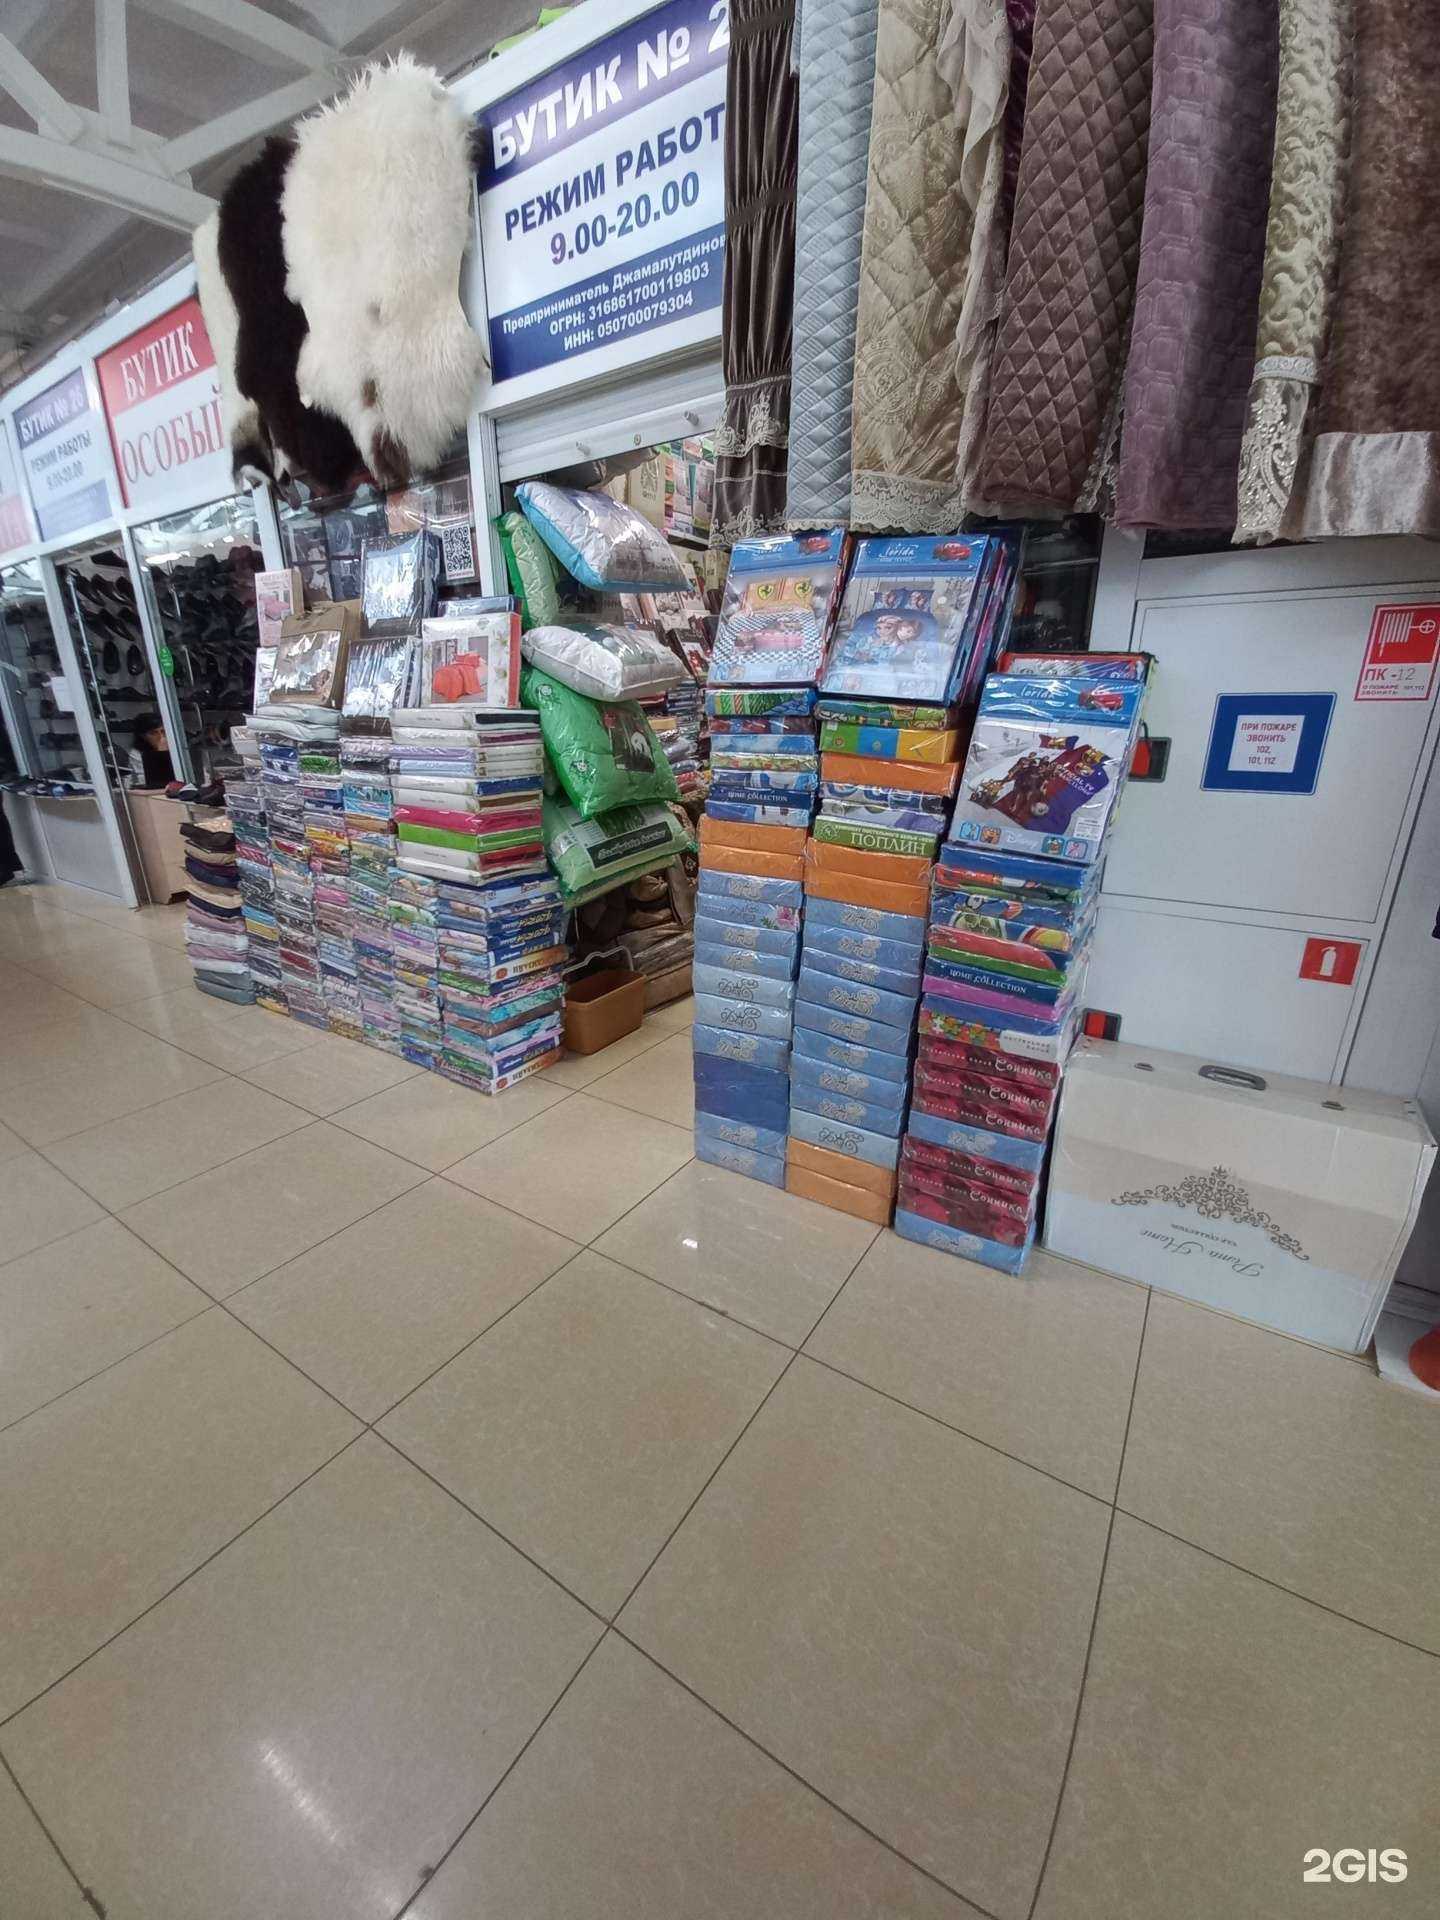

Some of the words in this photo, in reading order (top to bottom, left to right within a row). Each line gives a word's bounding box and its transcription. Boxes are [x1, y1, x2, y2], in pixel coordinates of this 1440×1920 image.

[492, 55, 623, 170] БУТИК
[637, 26, 691, 90] №
[505, 163, 605, 241] РЕЖИМ
[616, 103, 725, 187] РАБОТ
[550, 171, 700, 265] 9.00-20.00
[503, 284, 609, 334] Предприниматель
[549, 312, 586, 336] ОГРН:
[588, 262, 710, 321] 316861700119803
[564, 332, 594, 351] ИНН:
[120, 321, 200, 400] БУТИК
[20, 405, 54, 441] БУТИК
[121, 384, 224, 484] ОСОБЫЙ
[57, 429, 92, 460] РАБОТЫ
[1241, 723, 1258, 731] ПРИ
[1260, 723, 1297, 732] ПОЖАРЕ
[1247, 734, 1287, 743] ЗВОНИТЬ
[1264, 757, 1277, 765] 112
[850, 832, 927, 856] ПОПЛИН
[949, 968, 972, 980] HOME
[973, 974, 1027, 994] COLLECTION
